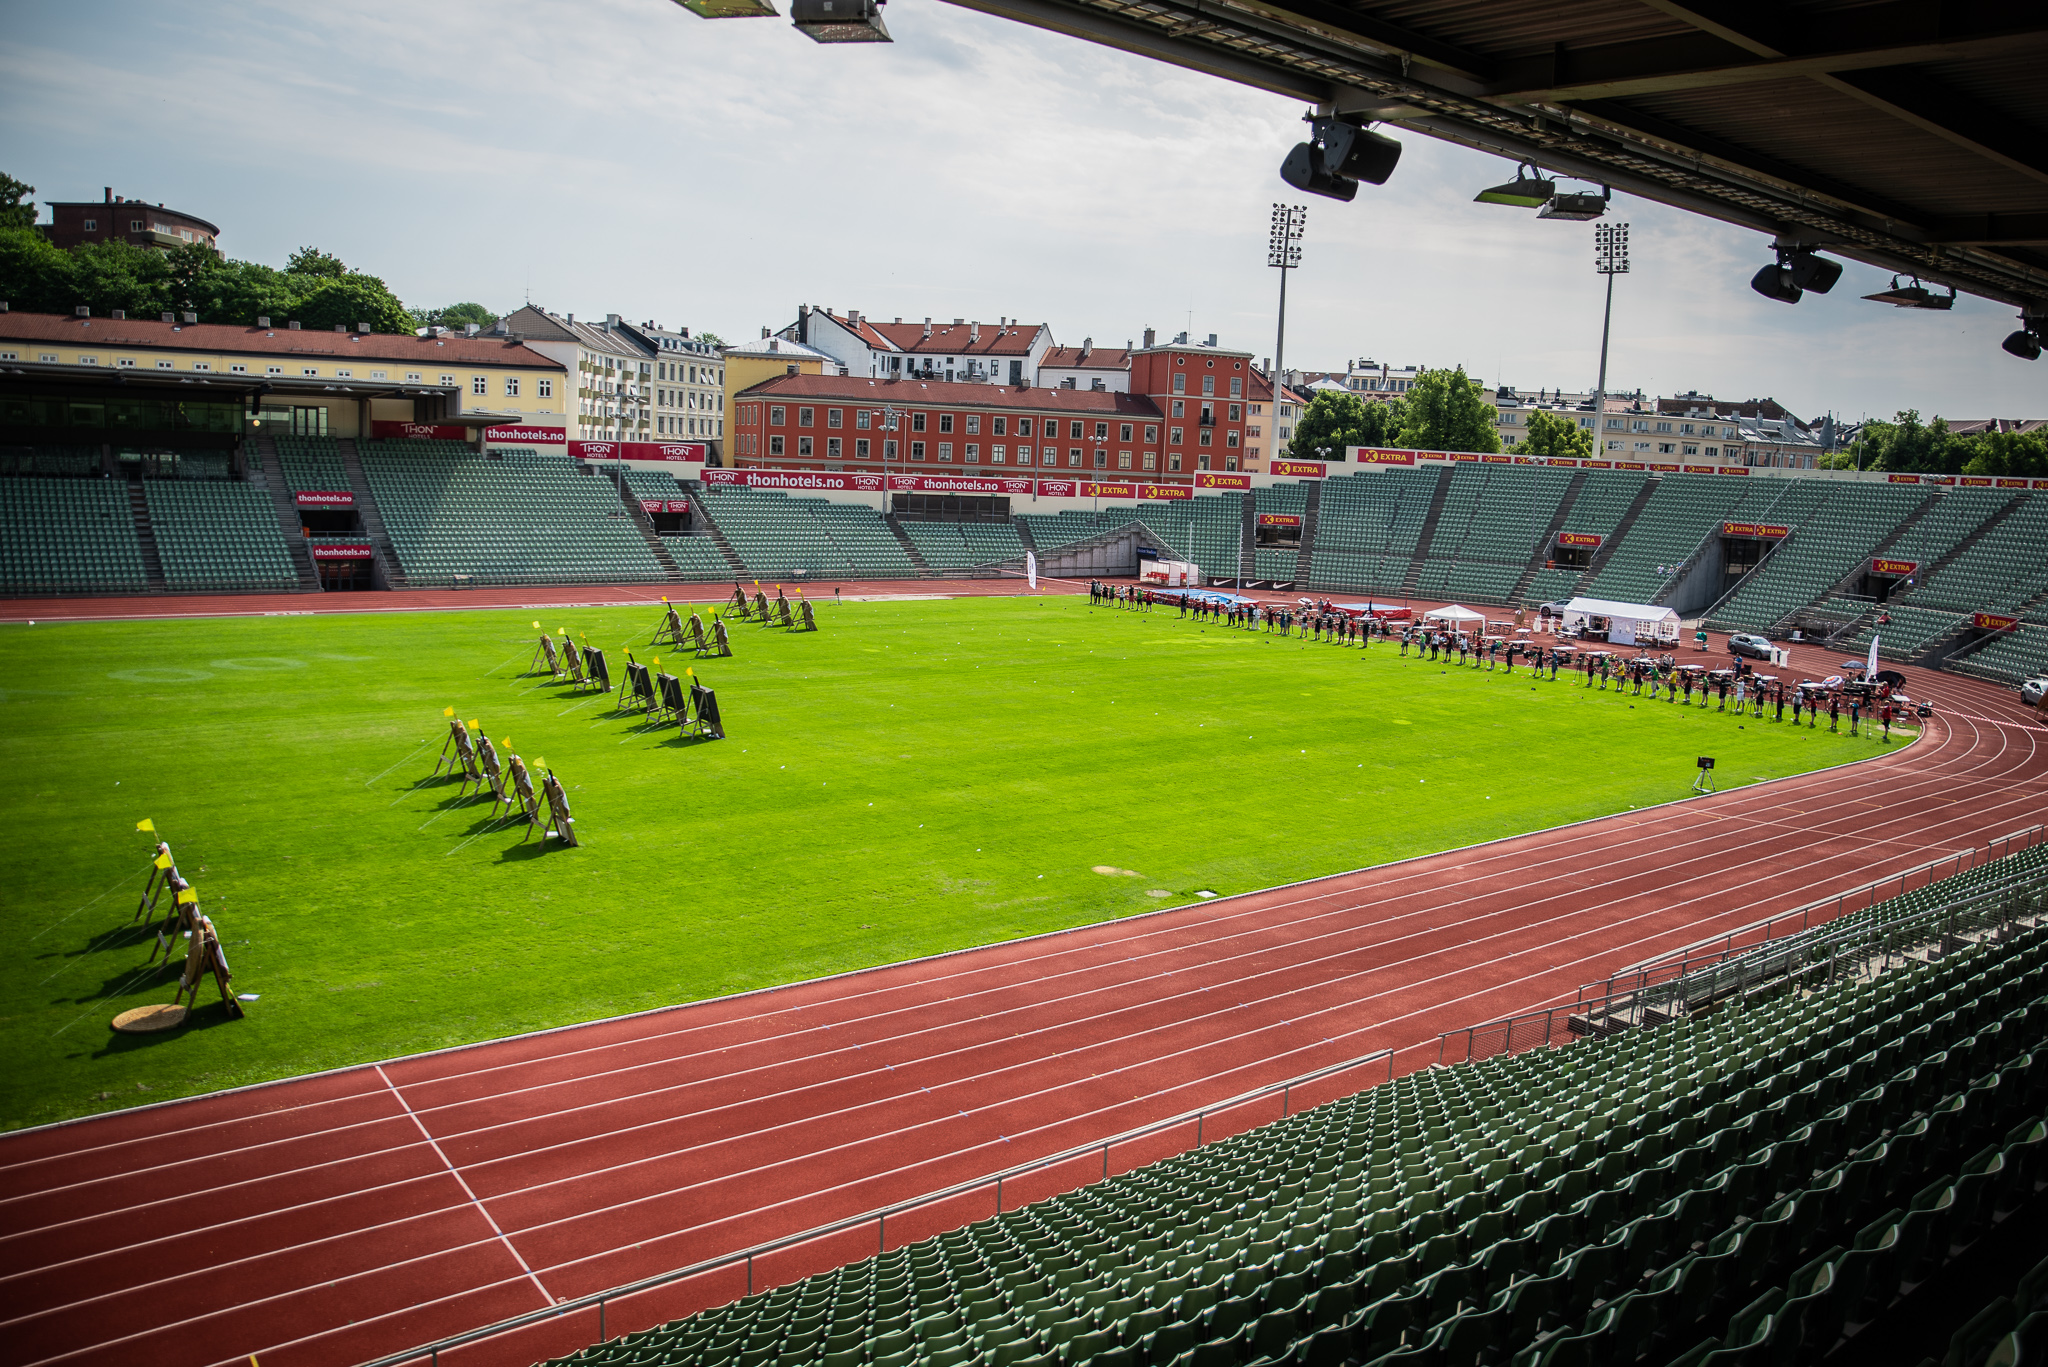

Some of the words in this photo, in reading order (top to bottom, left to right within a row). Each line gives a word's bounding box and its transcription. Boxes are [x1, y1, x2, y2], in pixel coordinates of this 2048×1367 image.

[401, 423, 438, 434] THON
[487, 429, 564, 441] thonhotels.no
[580, 442, 614, 453] THON
[659, 444, 693, 456] THON
[1380, 453, 1407, 462] EXTRA
[1292, 465, 1319, 474] EXTRA
[705, 470, 739, 481] THON
[851, 475, 883, 486] THON
[746, 473, 844, 489] thonhotels.no
[892, 476, 919, 486] THON
[923, 478, 999, 491] thonhotels.no
[1002, 480, 1029, 489] THON
[1042, 481, 1072, 491] THON
[1217, 478, 1243, 486] EXTRA
[1102, 486, 1129, 495] EXTRA
[1159, 489, 1185, 497] EXTRA
[298, 494, 352, 502] thonhotels.no
[315, 548, 370, 556] thonhotels.no
[1889, 564, 1910, 572] EXTRA
